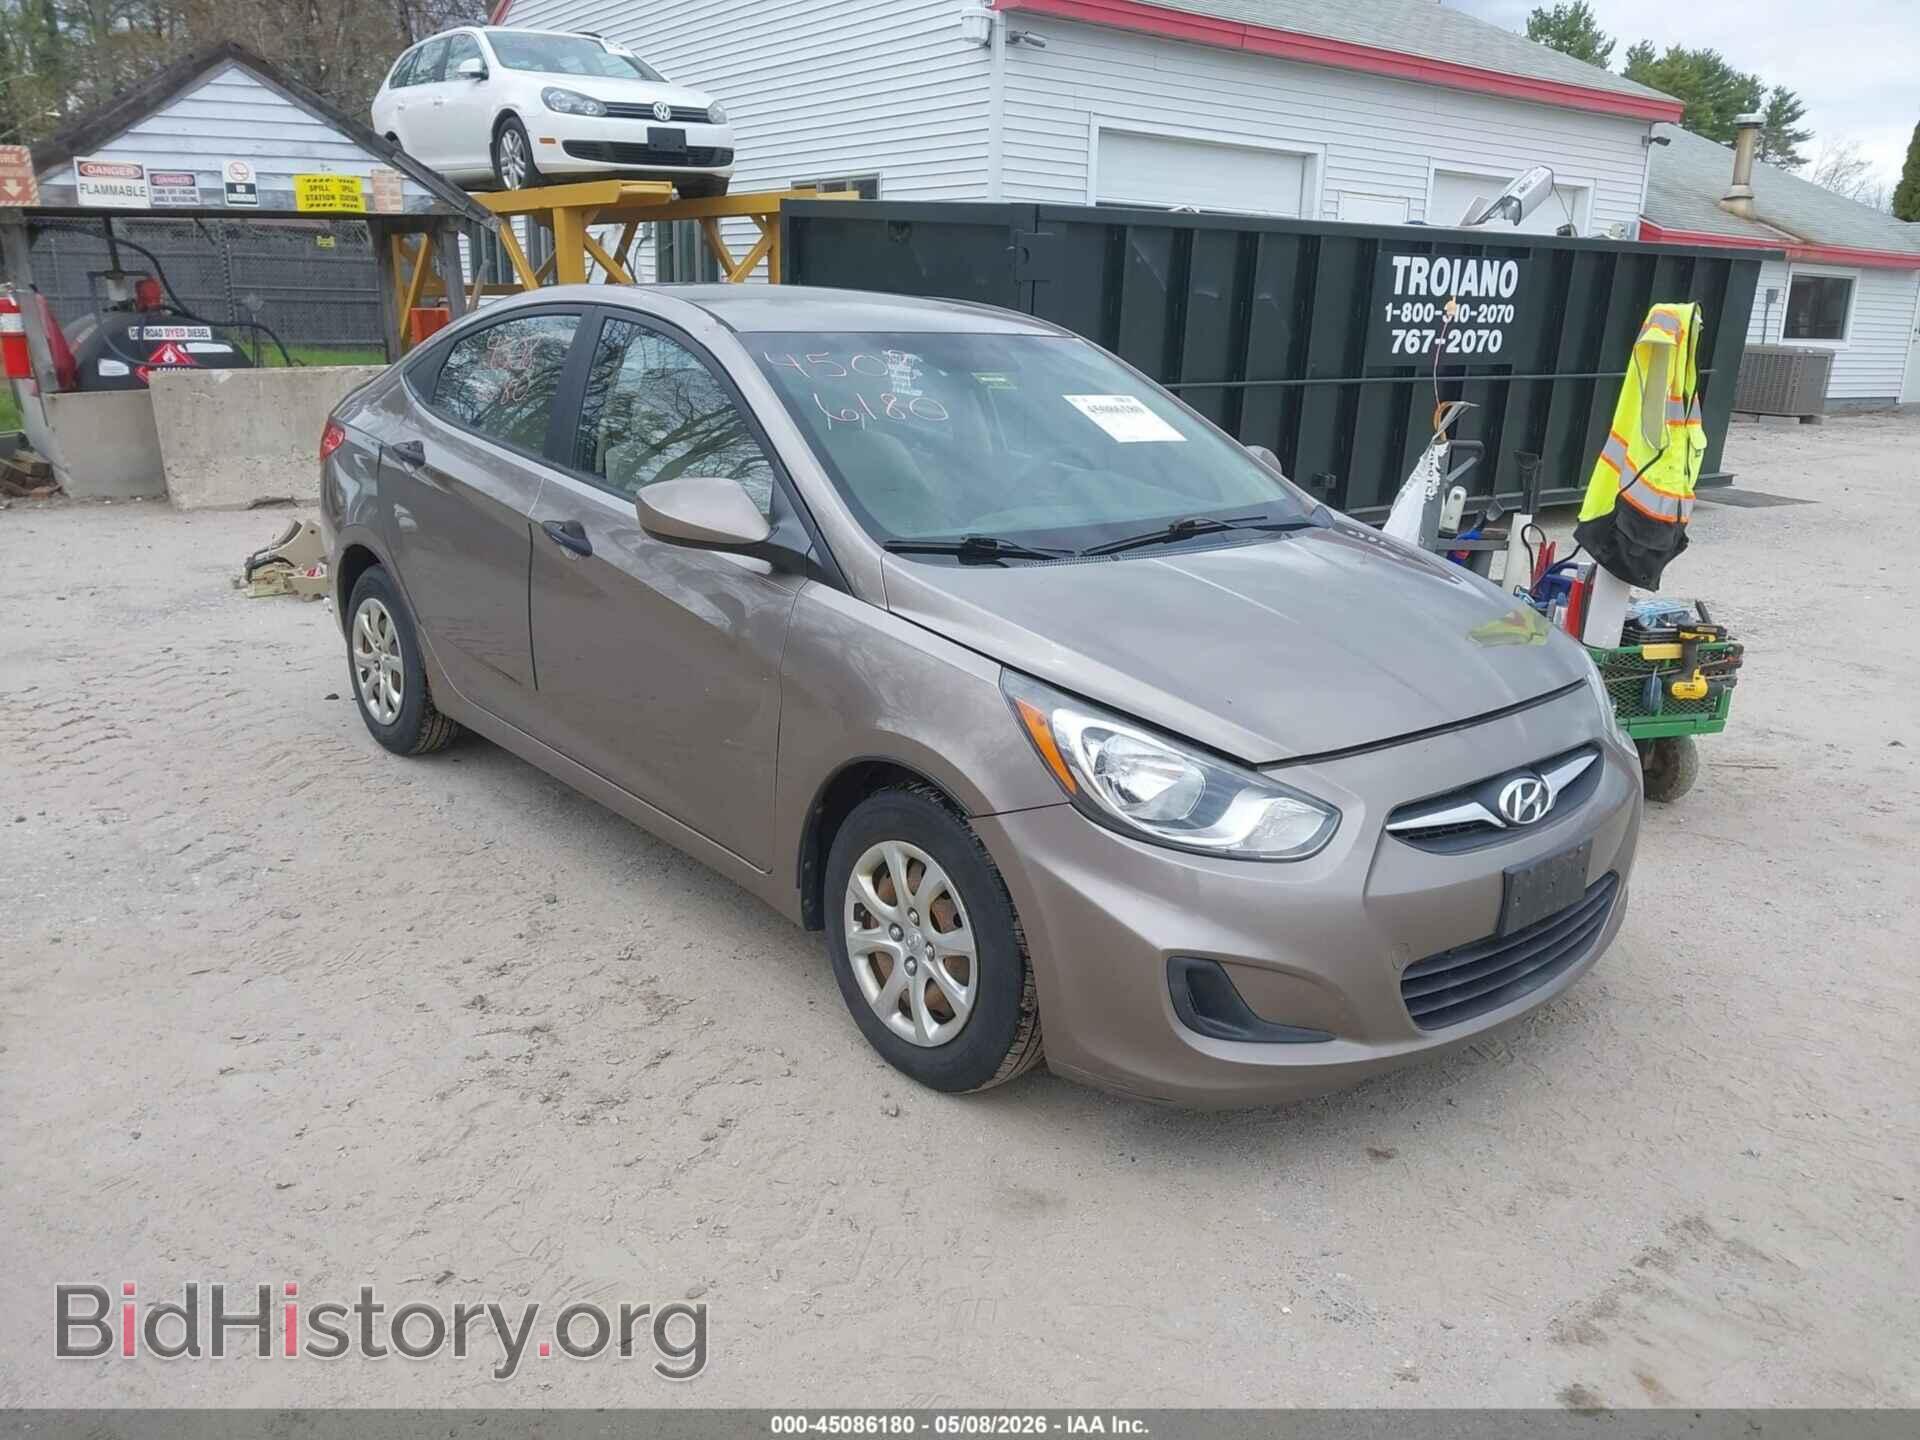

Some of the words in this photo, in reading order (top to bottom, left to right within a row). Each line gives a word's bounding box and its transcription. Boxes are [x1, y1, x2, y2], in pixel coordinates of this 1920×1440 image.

[86, 164, 135, 177] DANGER
[80, 183, 147, 197] FLAMMABLE
[309, 184, 329, 192] SPILL
[1392, 256, 1519, 298] TROIANO
[1385, 302, 1514, 323] 1-800-10-2070
[145, 328, 163, 338] ROAD
[165, 328, 186, 338] DYED
[187, 328, 210, 338] DIESEL
[1391, 329, 1503, 354] 767-2070
